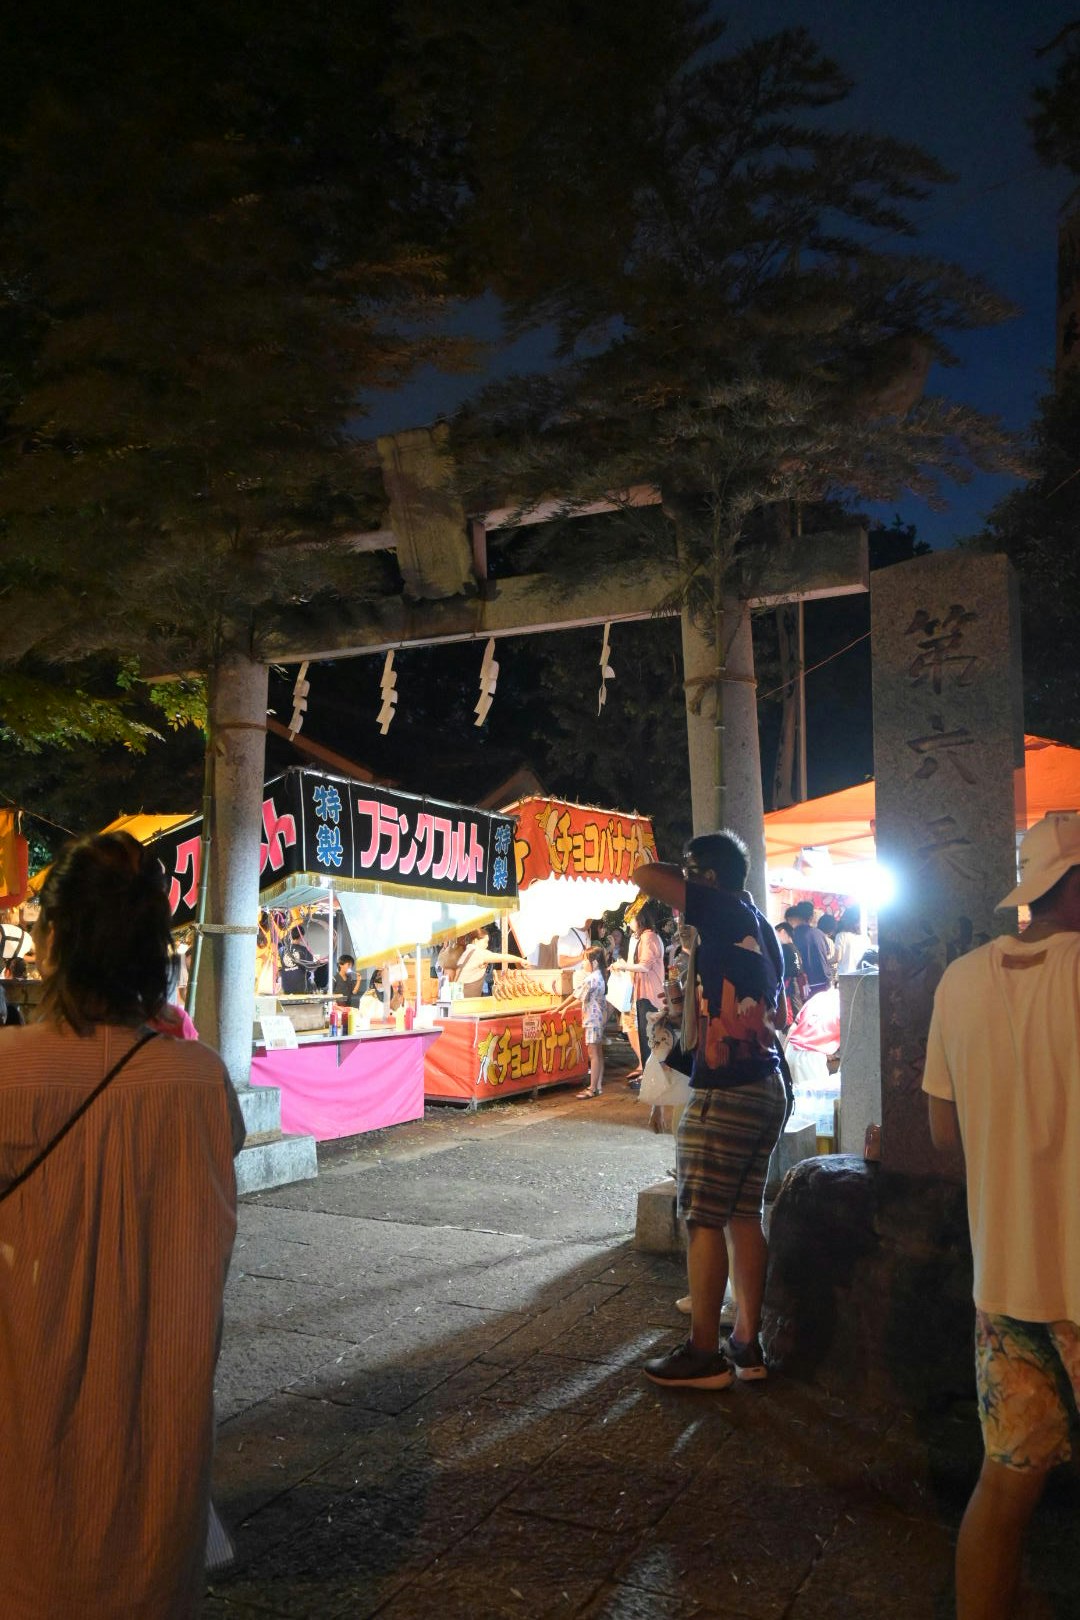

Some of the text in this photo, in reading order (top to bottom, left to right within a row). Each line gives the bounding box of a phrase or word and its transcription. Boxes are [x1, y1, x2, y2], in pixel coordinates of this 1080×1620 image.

[313, 785, 343, 868] 特製
[358, 799, 485, 884] フランクフルト
[492, 824, 513, 890] 特製
[556, 810, 639, 877] チョコバナナ
[498, 1019, 570, 1084] チョコバナナ
